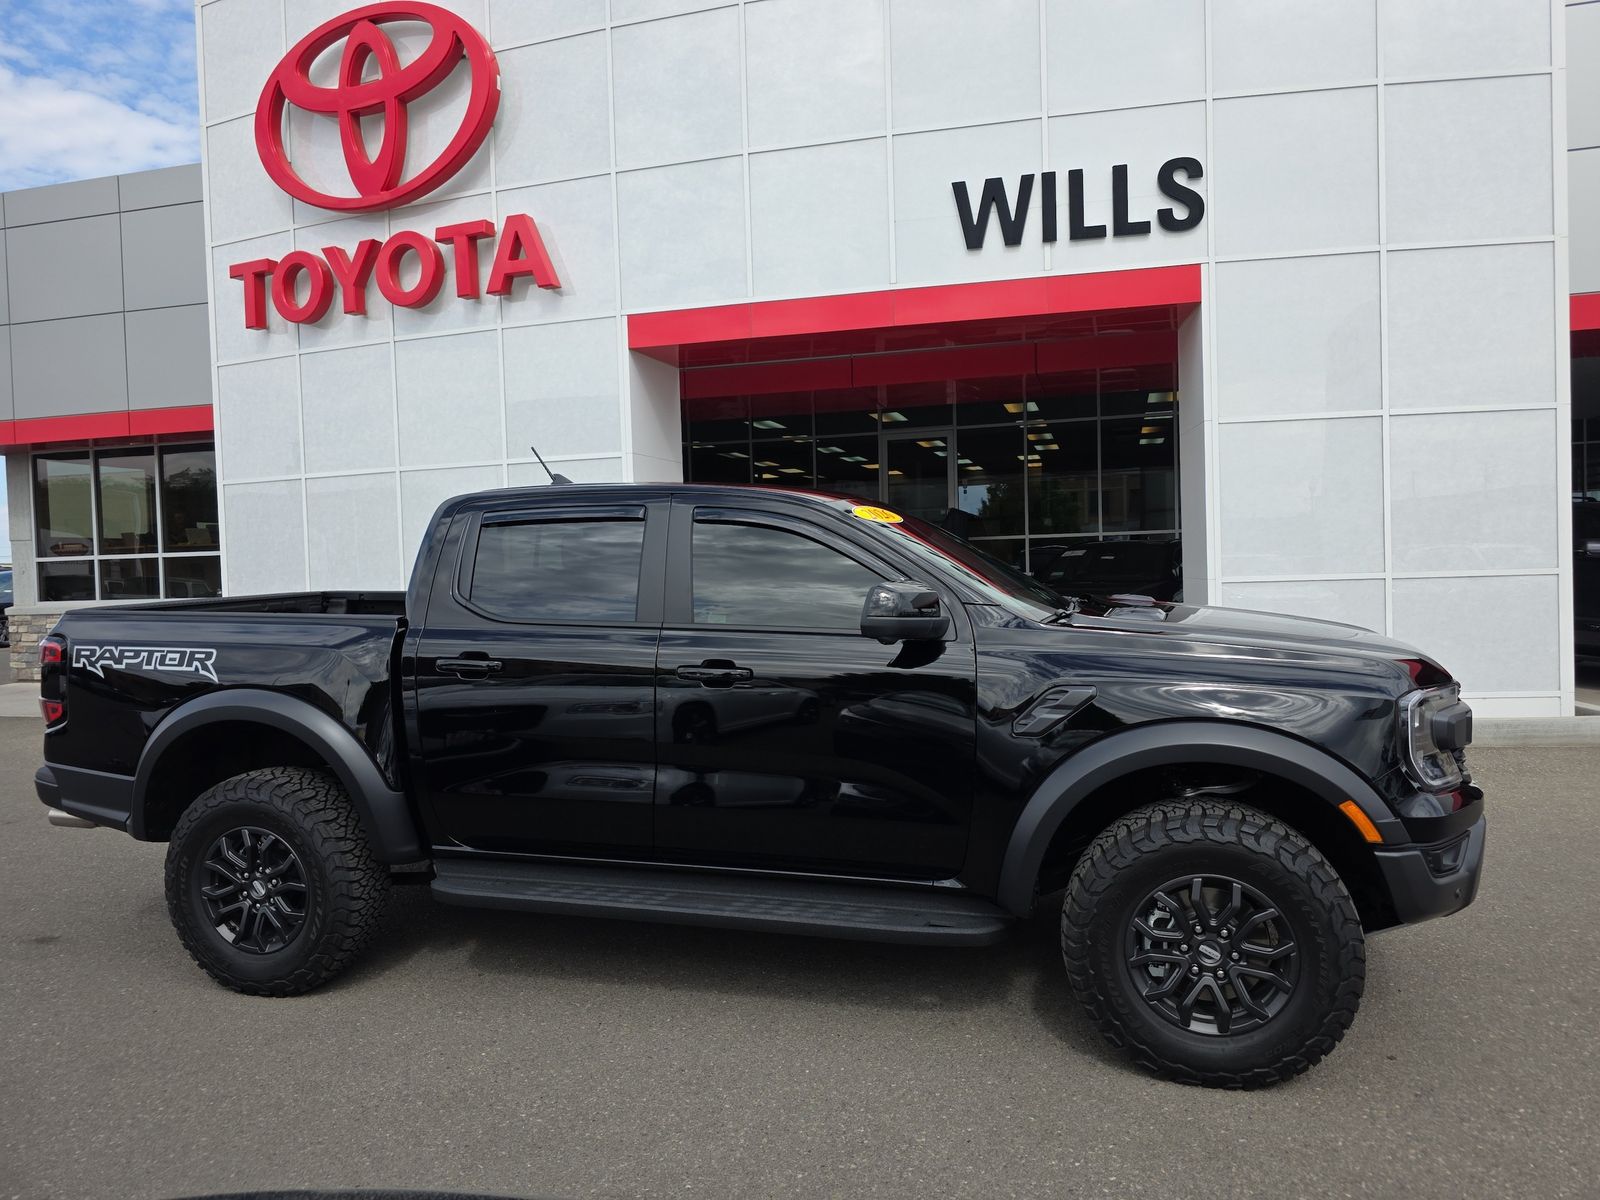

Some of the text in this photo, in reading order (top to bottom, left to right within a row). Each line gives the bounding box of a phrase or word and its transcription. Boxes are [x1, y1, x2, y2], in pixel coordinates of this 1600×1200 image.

[951, 156, 1205, 250] WILLS
[229, 213, 561, 330] TOYOTA
[72, 645, 219, 684] RAPTOR
